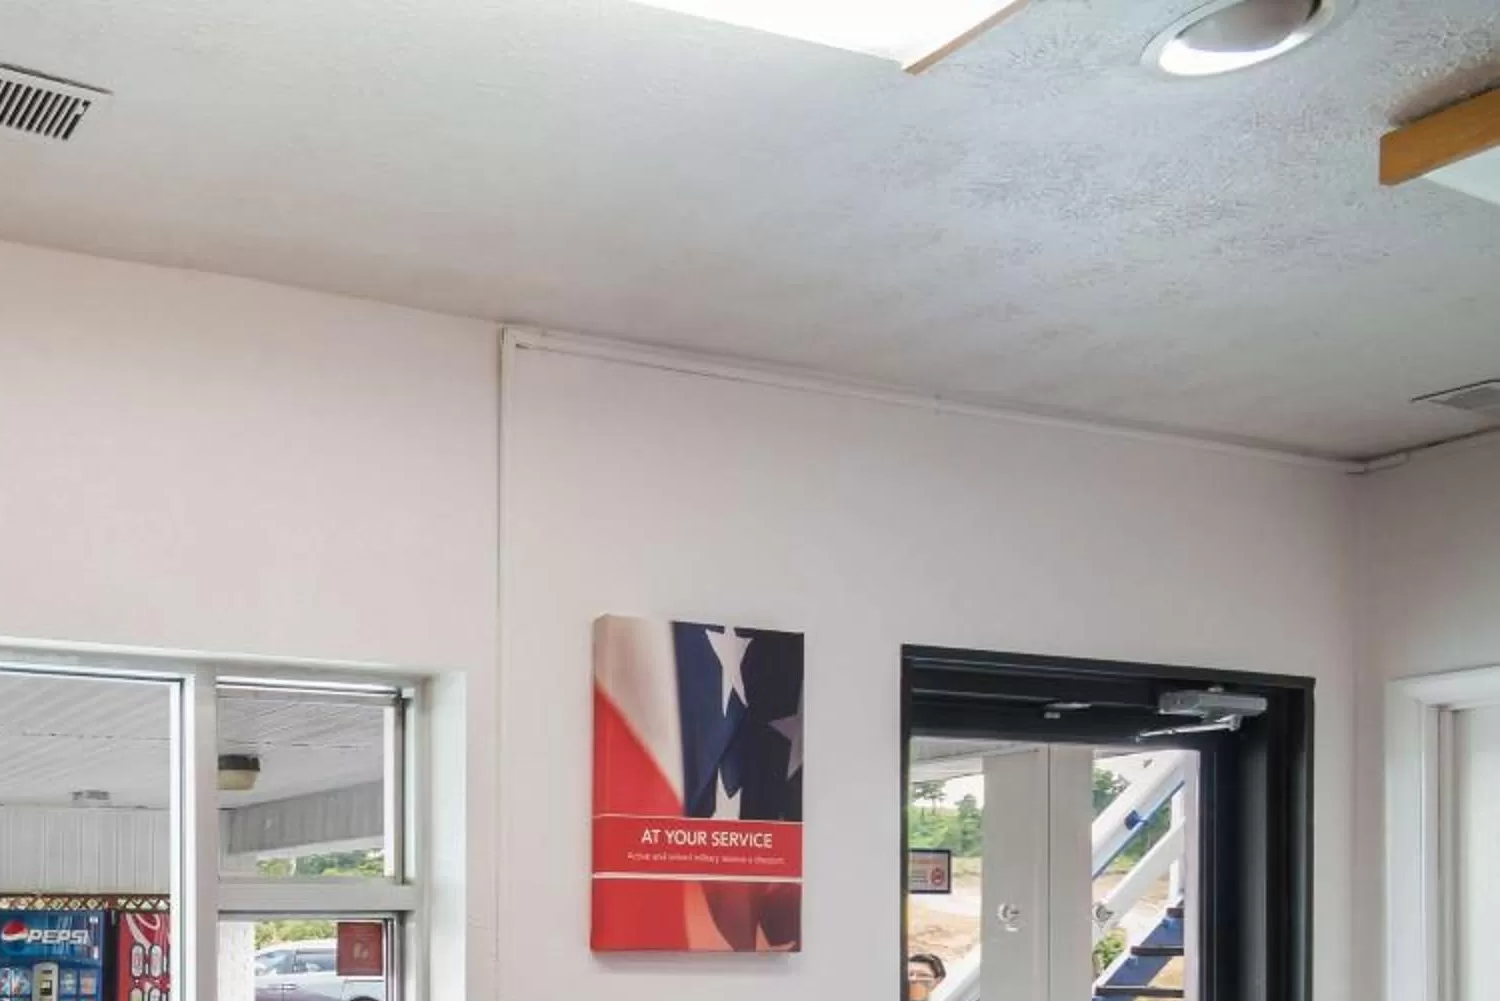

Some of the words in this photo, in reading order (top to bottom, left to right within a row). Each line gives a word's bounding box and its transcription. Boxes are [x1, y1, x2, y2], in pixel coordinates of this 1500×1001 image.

[641, 828, 661, 845] AT
[665, 829, 708, 846] YOUR
[711, 831, 773, 849] SERVICE
[26, 929, 89, 945] PEPSI
